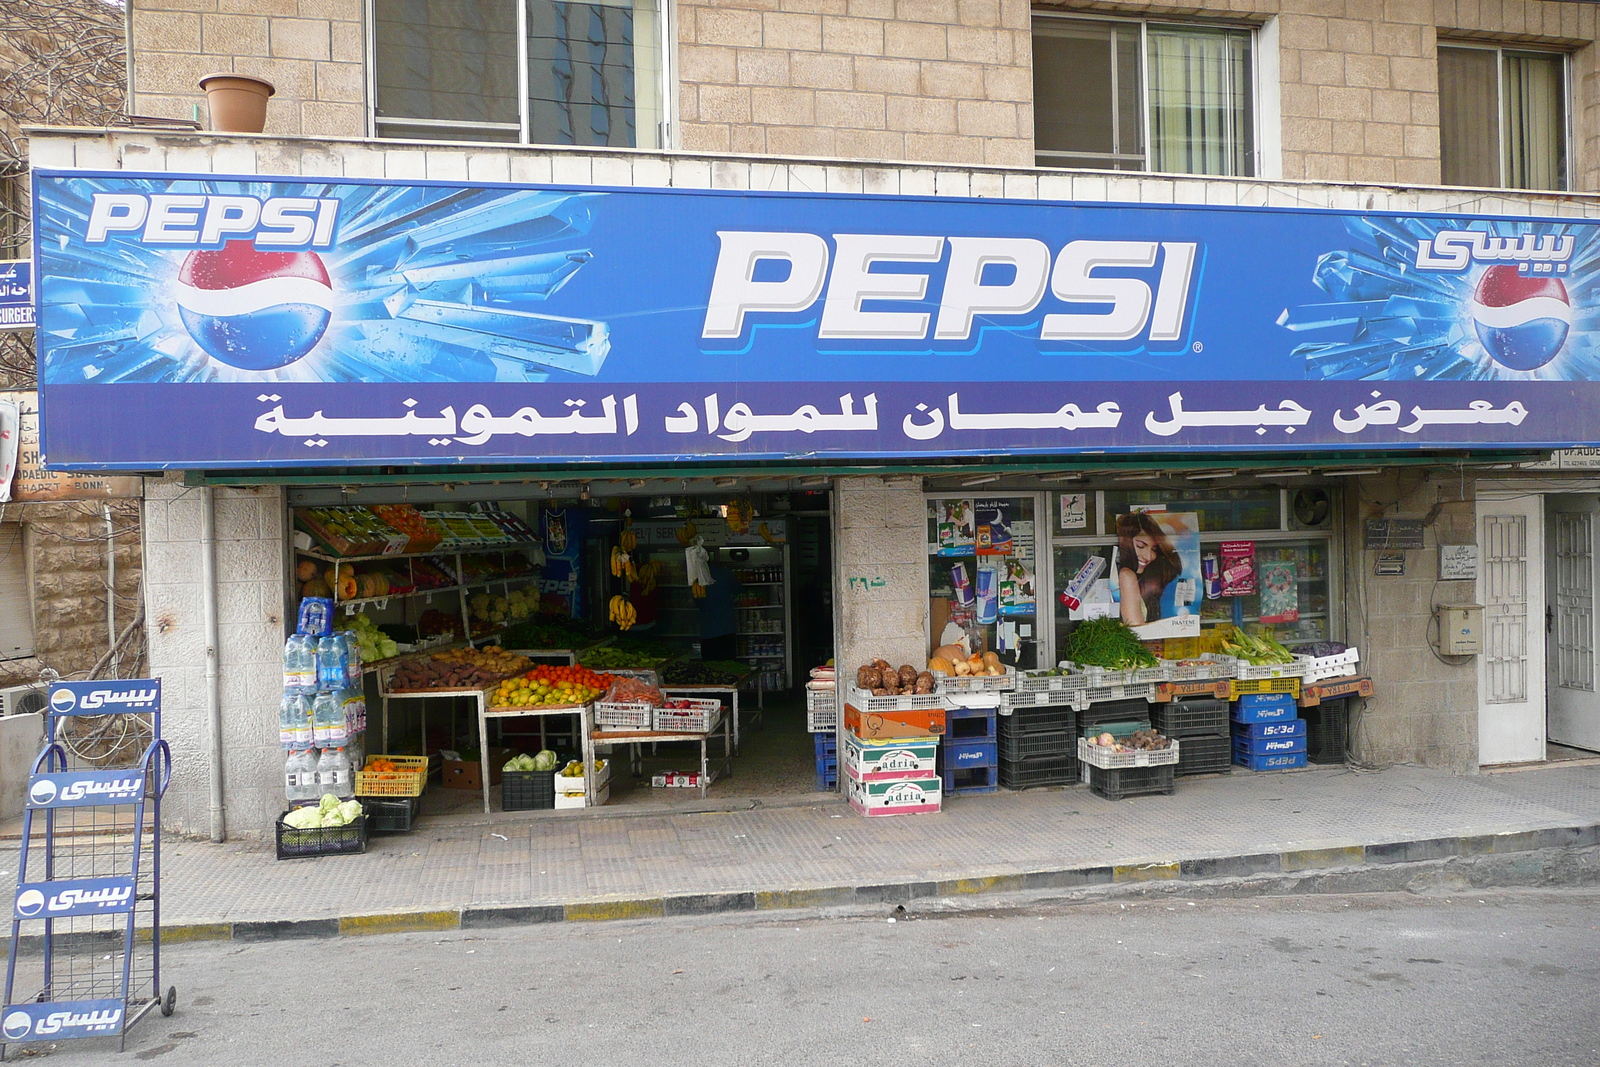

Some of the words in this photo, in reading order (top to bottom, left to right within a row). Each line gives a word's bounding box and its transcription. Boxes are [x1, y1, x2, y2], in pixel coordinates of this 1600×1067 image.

[85, 193, 340, 246] PEPSI
[702, 230, 1198, 341] PEPSI
[253, 393, 639, 448] التموينية
[664, 392, 878, 442] للمواد
[902, 392, 1123, 441] عمان
[1144, 391, 1312, 437] جبل
[1333, 390, 1528, 434] معرض
[75, 481, 104, 490] BONN
[1181, 683, 1205, 692] PETRA
[1327, 683, 1351, 694] PETRA
[1264, 725, 1295, 735] PEPSI
[882, 759, 915, 768] adria
[888, 791, 921, 802] adria
